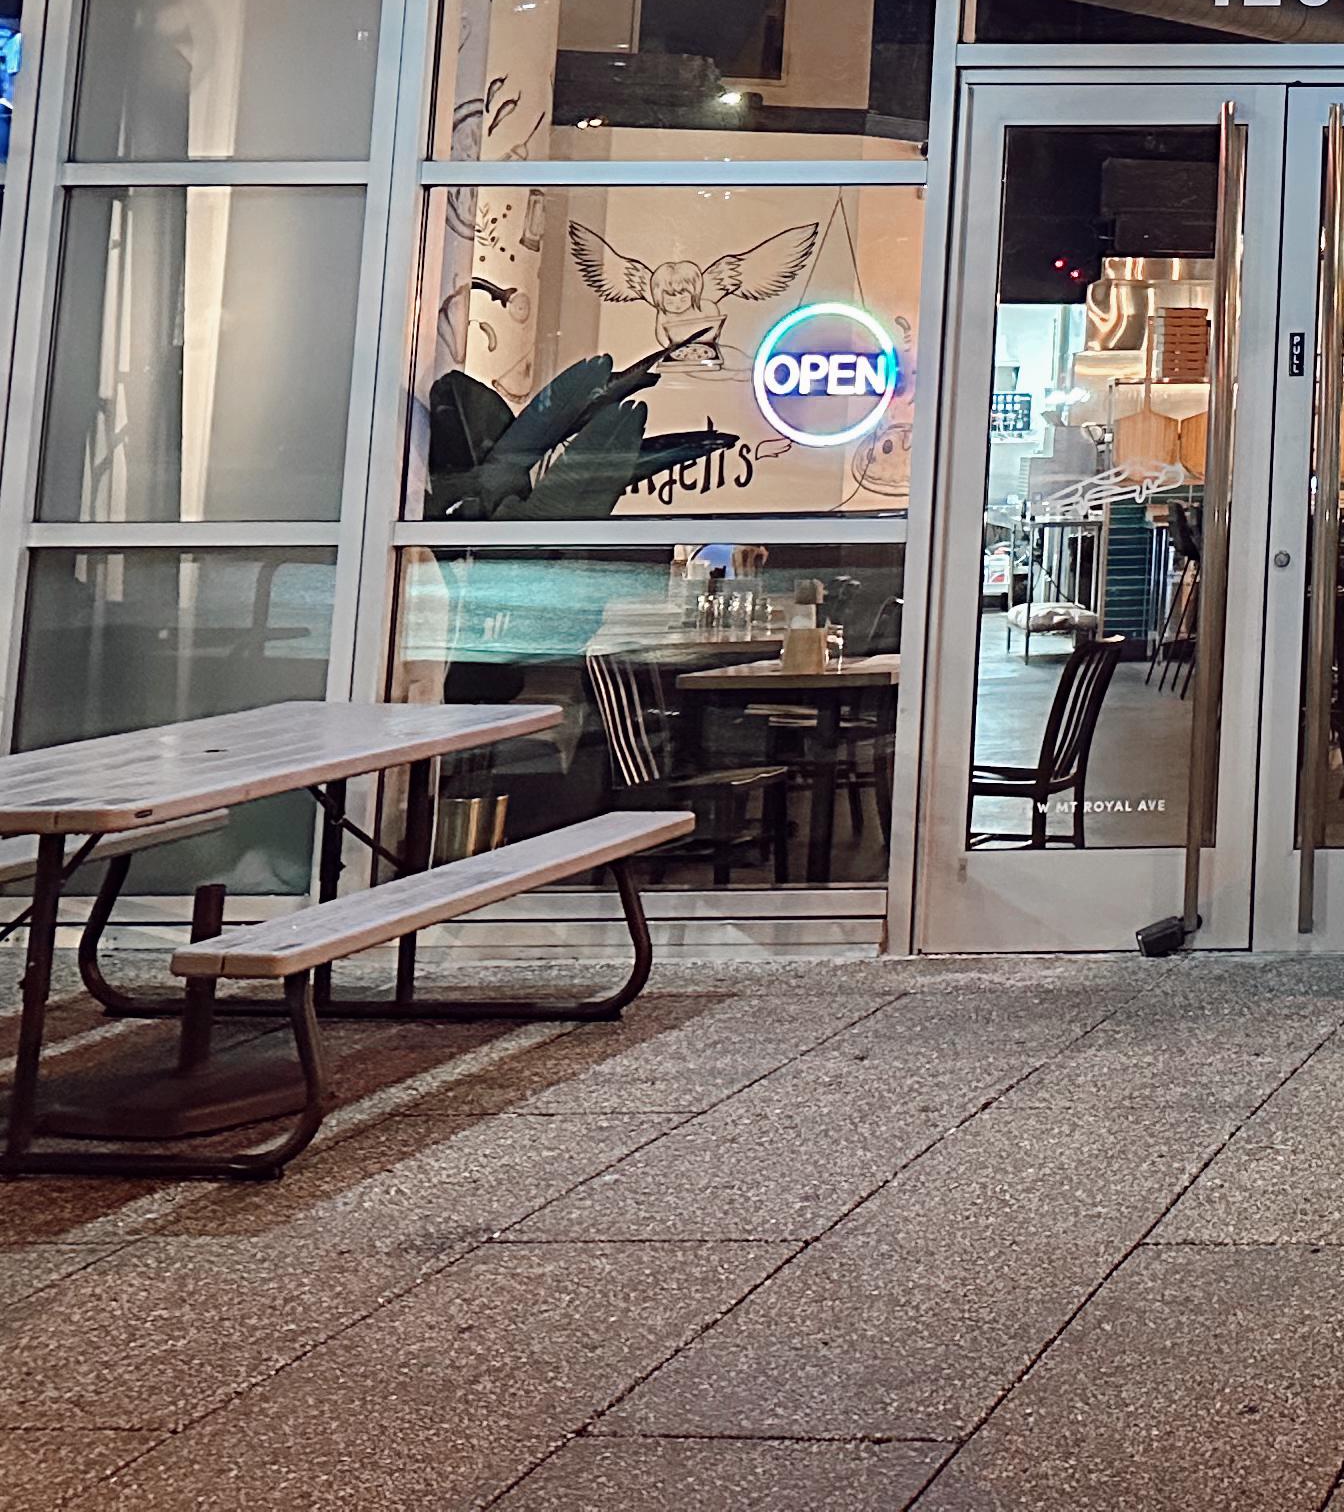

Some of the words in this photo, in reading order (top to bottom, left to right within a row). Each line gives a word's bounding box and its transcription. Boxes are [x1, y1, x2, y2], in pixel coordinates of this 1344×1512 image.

[1293, 336, 1301, 373] PULL
[764, 354, 887, 395] OPEN
[1037, 802, 1049, 813] W
[1055, 801, 1078, 813] MT
[1083, 800, 1132, 813] ROYAL
[1137, 799, 1166, 812] AVE
